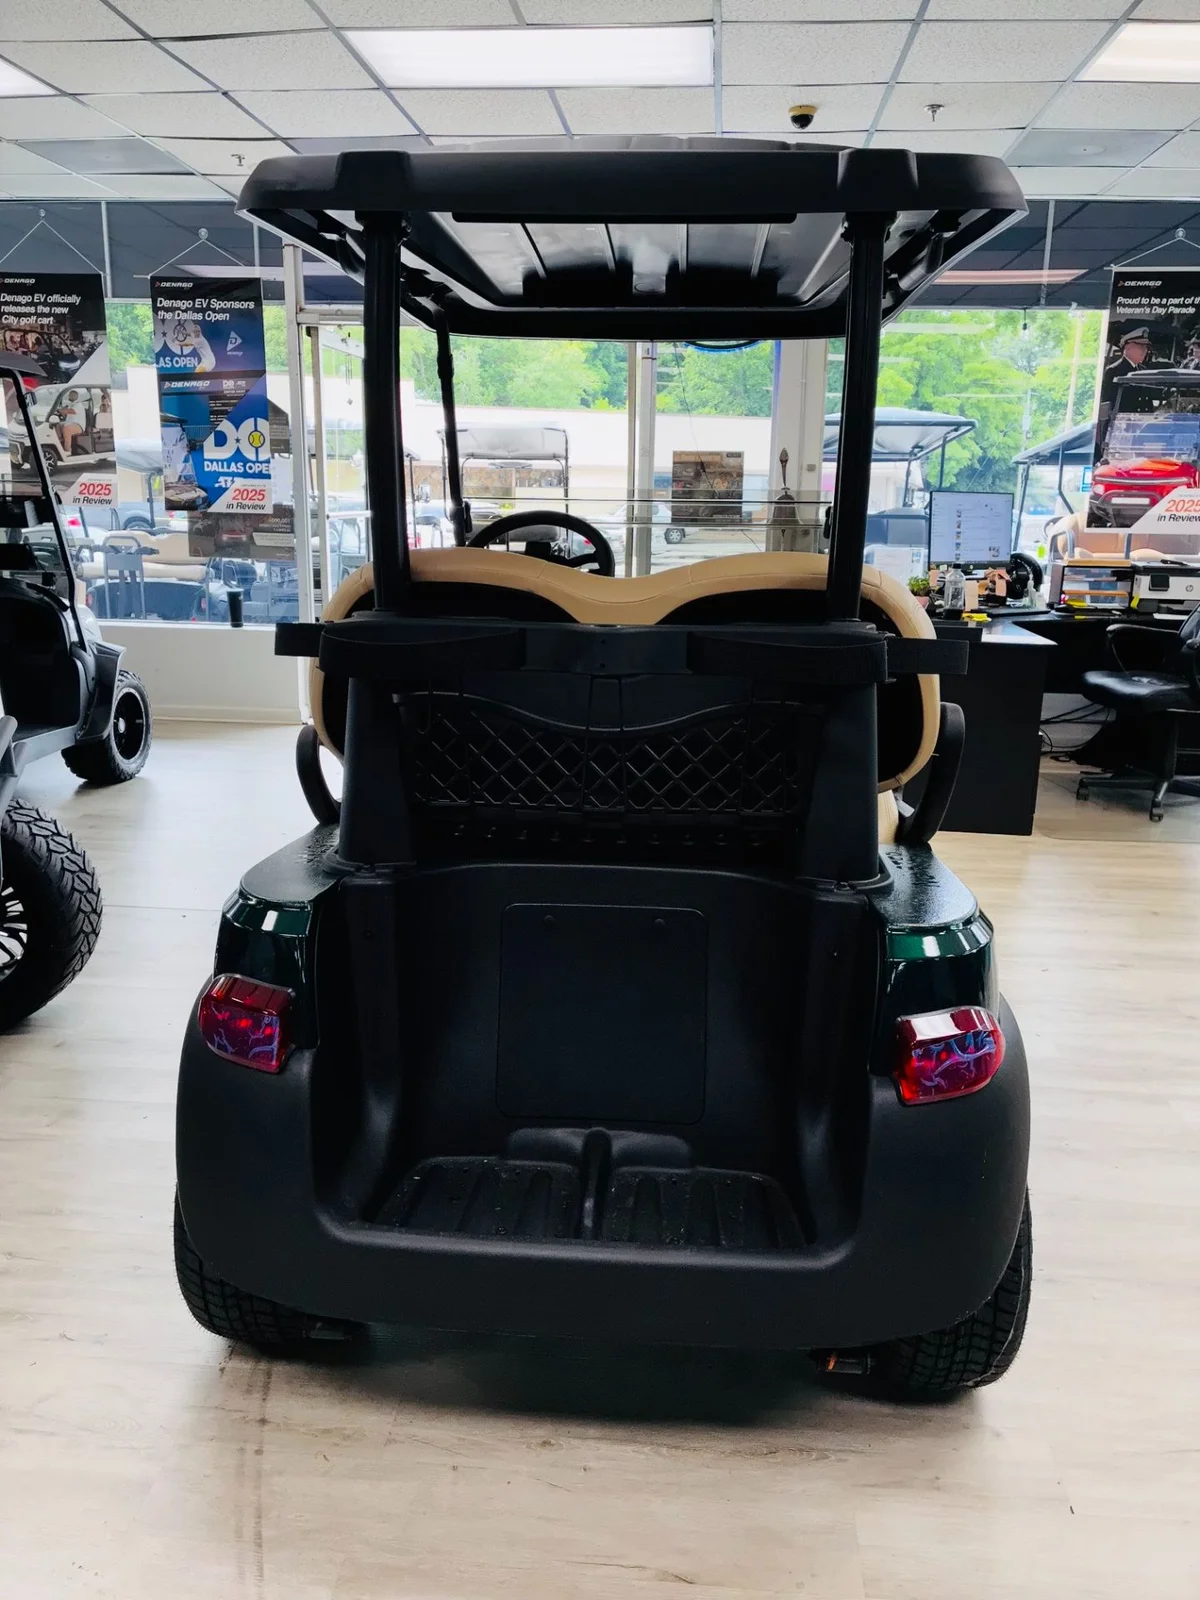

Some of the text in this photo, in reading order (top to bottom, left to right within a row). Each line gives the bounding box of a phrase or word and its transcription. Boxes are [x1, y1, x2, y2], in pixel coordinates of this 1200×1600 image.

[0, 293, 81, 305] Denago EV officially
[157, 297, 255, 310] Denago EV Sponsors
[1116, 296, 1140, 305] Proud
[1141, 296, 1150, 305] to
[1150, 296, 1161, 305] be
[1167, 297, 1184, 306] part
[1185, 296, 1195, 305] of
[0, 304, 36, 313] releases
[37, 305, 51, 313] the
[1116, 306, 1196, 316] Veteran's Day Parade
[1, 315, 54, 325] City golf cart
[157, 310, 230, 323] the Dallas Open
[173, 357, 198, 368] OPEN
[170, 380, 210, 388] DENAGO
[204, 461, 271, 474] DALLAS OPE
[78, 482, 112, 496] 2025
[232, 488, 266, 501] 2025
[72, 496, 112, 505] in Review
[226, 501, 266, 510] in Review
[1157, 514, 1167, 522] in
